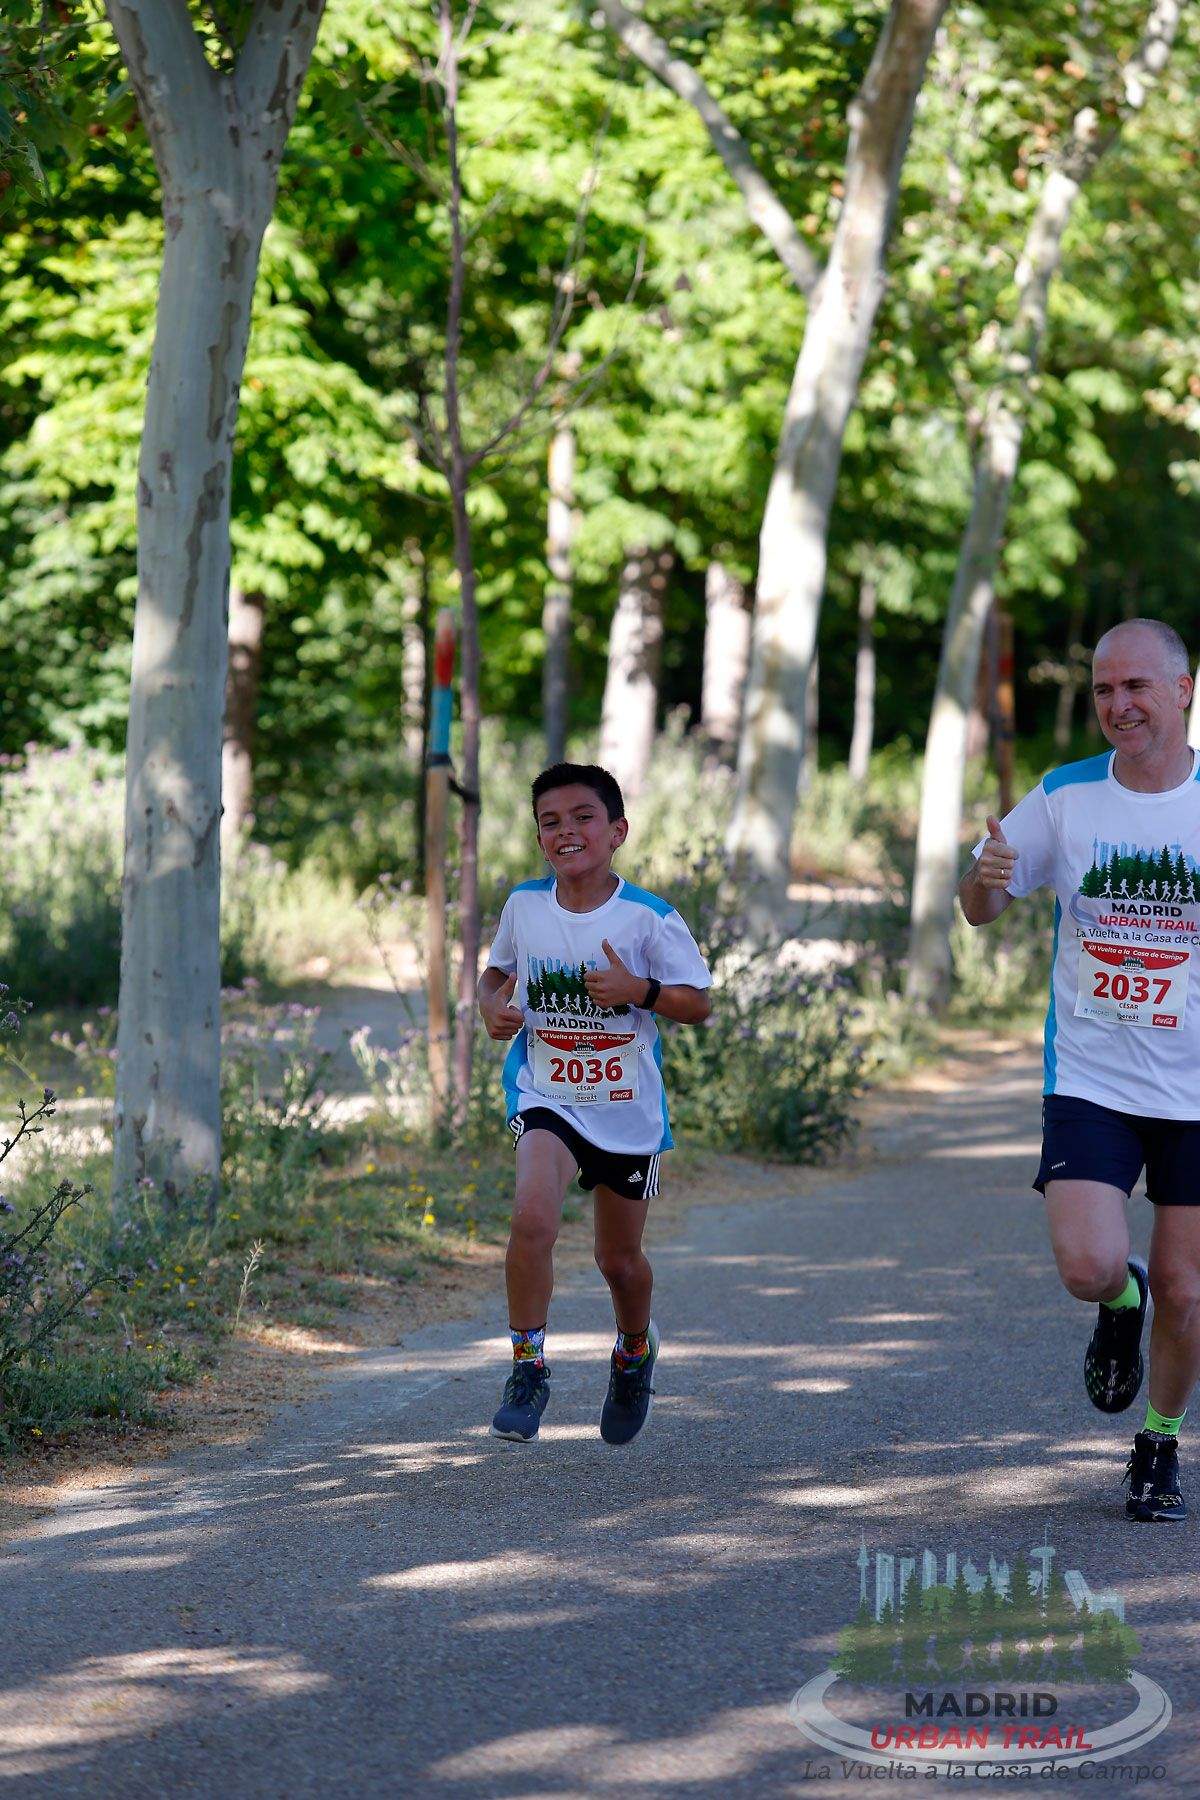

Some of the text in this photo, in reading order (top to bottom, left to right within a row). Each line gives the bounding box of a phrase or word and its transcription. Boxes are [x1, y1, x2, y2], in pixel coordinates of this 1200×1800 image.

[1111, 902, 1183, 917] MADRID
[1099, 914, 1198, 932] URBAN TRAIL
[1076, 928, 1086, 938] La
[1089, 929, 1120, 940] Vuelta
[1123, 932, 1129, 940] a
[1132, 931, 1142, 941] la
[1144, 932, 1172, 943] Casa
[1174, 934, 1189, 944] de
[1097, 945, 1117, 954] Vuelta
[1123, 947, 1130, 955] la
[1133, 949, 1149, 957] Casa
[1160, 953, 1184, 961] Campo
[1093, 971, 1172, 1005] 2037
[1118, 1002, 1139, 1010] CÉSAR
[546, 1016, 605, 1031] MADRID
[549, 1056, 623, 1084] 2036
